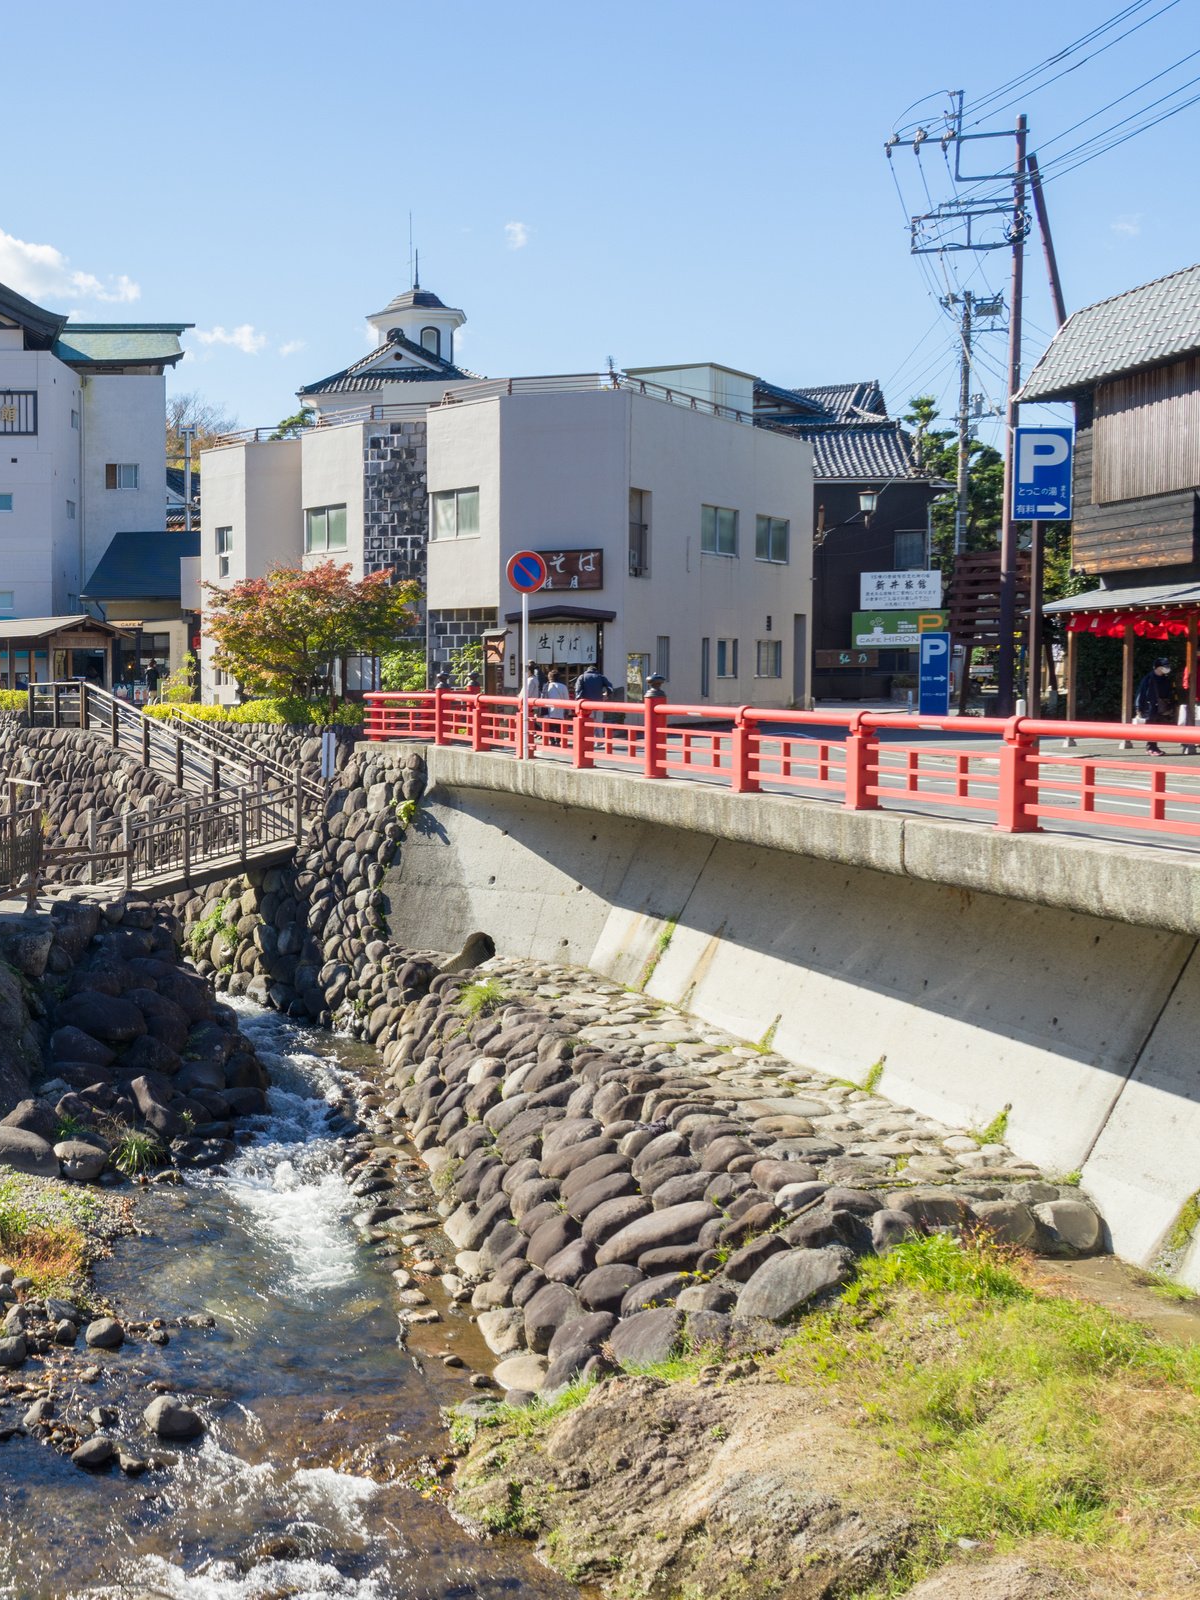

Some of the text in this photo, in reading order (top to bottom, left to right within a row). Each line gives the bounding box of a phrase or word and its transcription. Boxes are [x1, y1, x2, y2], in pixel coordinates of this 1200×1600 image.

[1019, 434, 1069, 483] P
[1018, 486, 1058, 496] とっこの湯
[1016, 504, 1035, 514] 有料
[549, 552, 599, 573] そば
[875, 579, 927, 590] 新井旅館
[918, 614, 943, 633] P
[538, 632, 581, 651] 生そば
[922, 638, 947, 664] P
